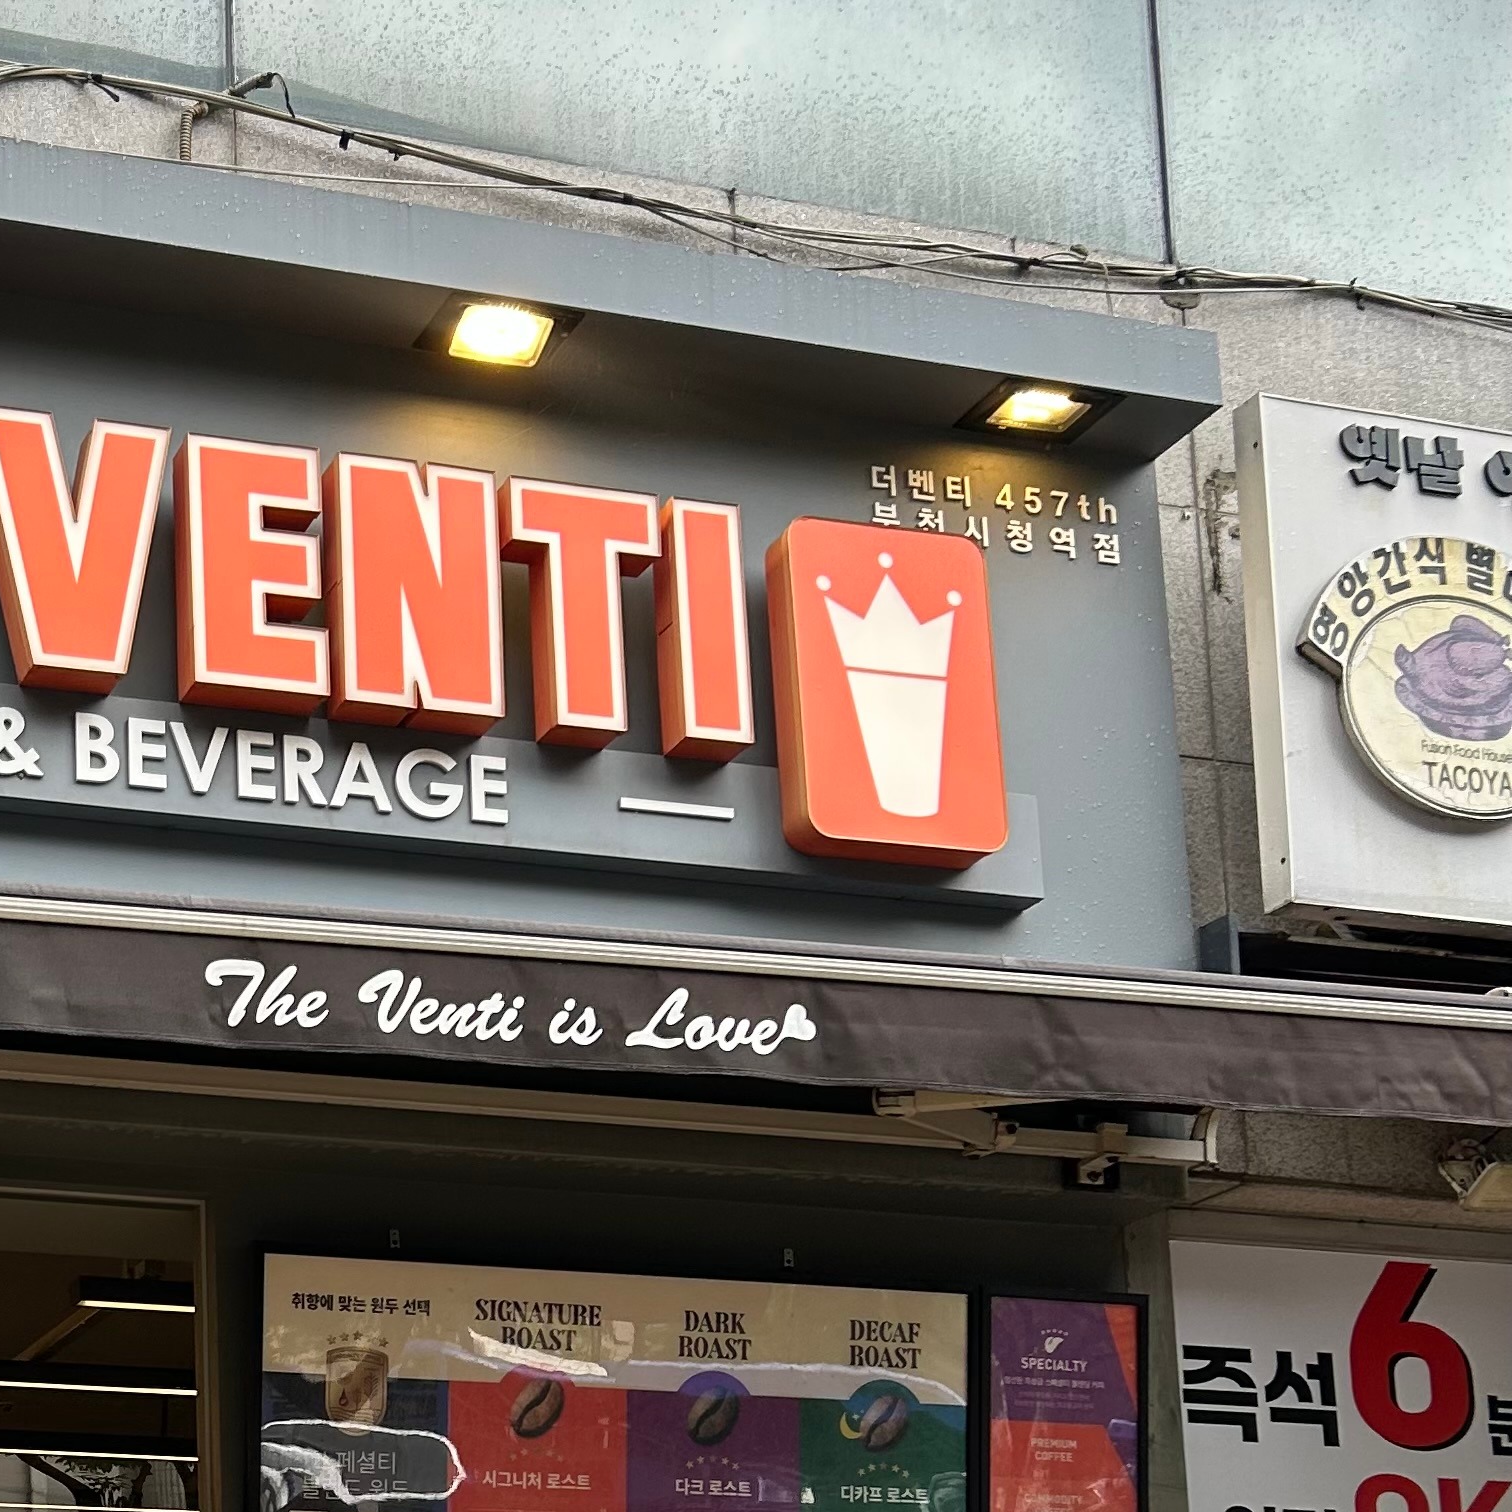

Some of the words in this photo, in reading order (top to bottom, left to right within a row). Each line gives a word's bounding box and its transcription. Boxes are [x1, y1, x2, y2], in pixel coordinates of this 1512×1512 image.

[1339, 423, 1465, 499] 옛날
[870, 464, 971, 509] 더벤티
[995, 483, 1118, 525] 457th
[872, 501, 1121, 566] 부천시청역점
[1311, 537, 1448, 657] 영양간식
[1465, 541, 1512, 602] 별
[1453, 744, 1480, 760] Food
[75, 710, 510, 825] BEVERAGE
[204, 957, 330, 1029] The
[357, 968, 525, 1042] Venti
[547, 997, 605, 1047] is
[624, 986, 793, 1056] Love
[291, 1292, 334, 1312] 취향에
[338, 1295, 367, 1313] 맞는
[370, 1297, 399, 1315] 원두
[403, 1298, 431, 1317] 선택
[474, 1297, 602, 1328] SIGNATURE
[683, 1309, 747, 1335] DARK
[848, 1318, 922, 1344] DECAF
[500, 1325, 578, 1352] ROAST
[677, 1335, 753, 1362] ROAST
[848, 1344, 922, 1370] ROAST
[1020, 1357, 1088, 1373] SPECIALTY
[1182, 1344, 1341, 1448] 즉석
[482, 1469, 542, 1490] 시그니처
[546, 1472, 591, 1490] 로스트
[675, 1477, 705, 1496] 다크
[708, 1479, 752, 1497] 로스트
[840, 1485, 883, 1504] 디카프
[886, 1487, 930, 1505] 로스트
